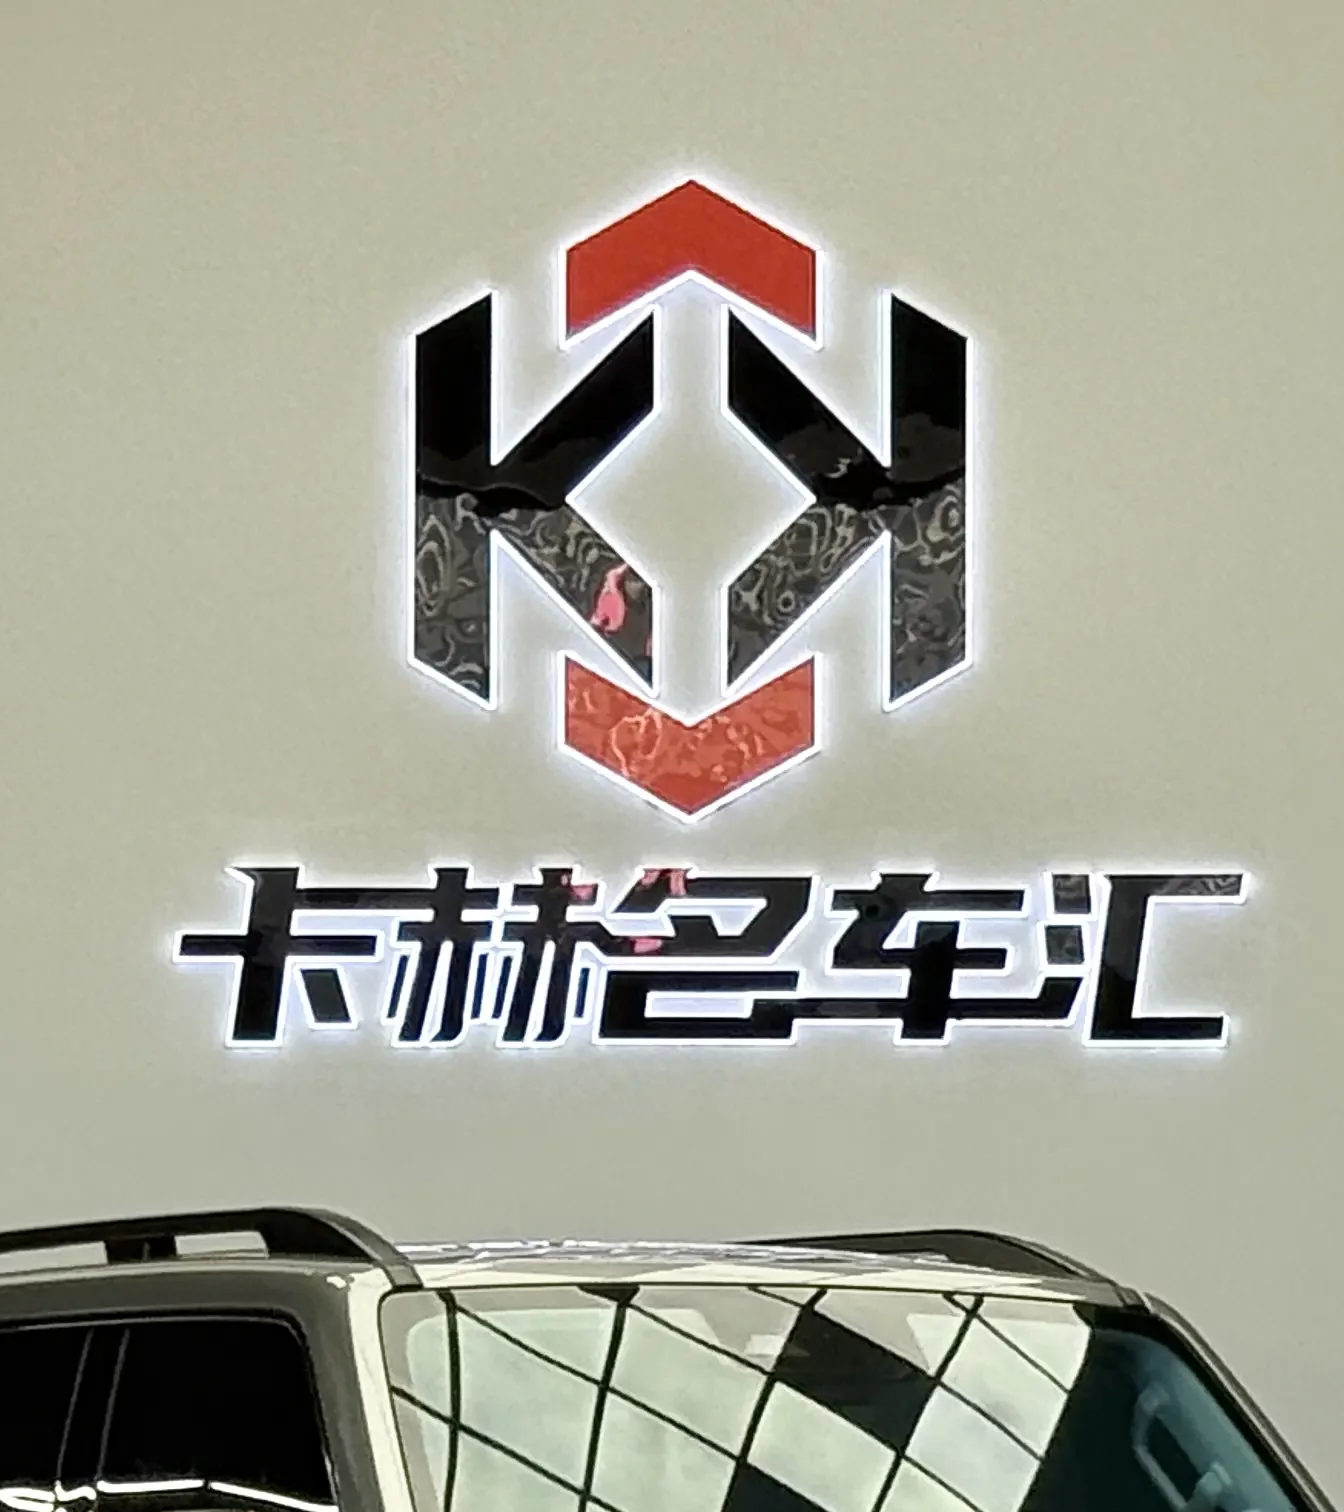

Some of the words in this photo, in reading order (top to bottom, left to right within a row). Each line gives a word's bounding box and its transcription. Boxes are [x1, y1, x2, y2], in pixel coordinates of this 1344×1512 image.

[176, 865, 1248, 1044] 卡赫名车汇
